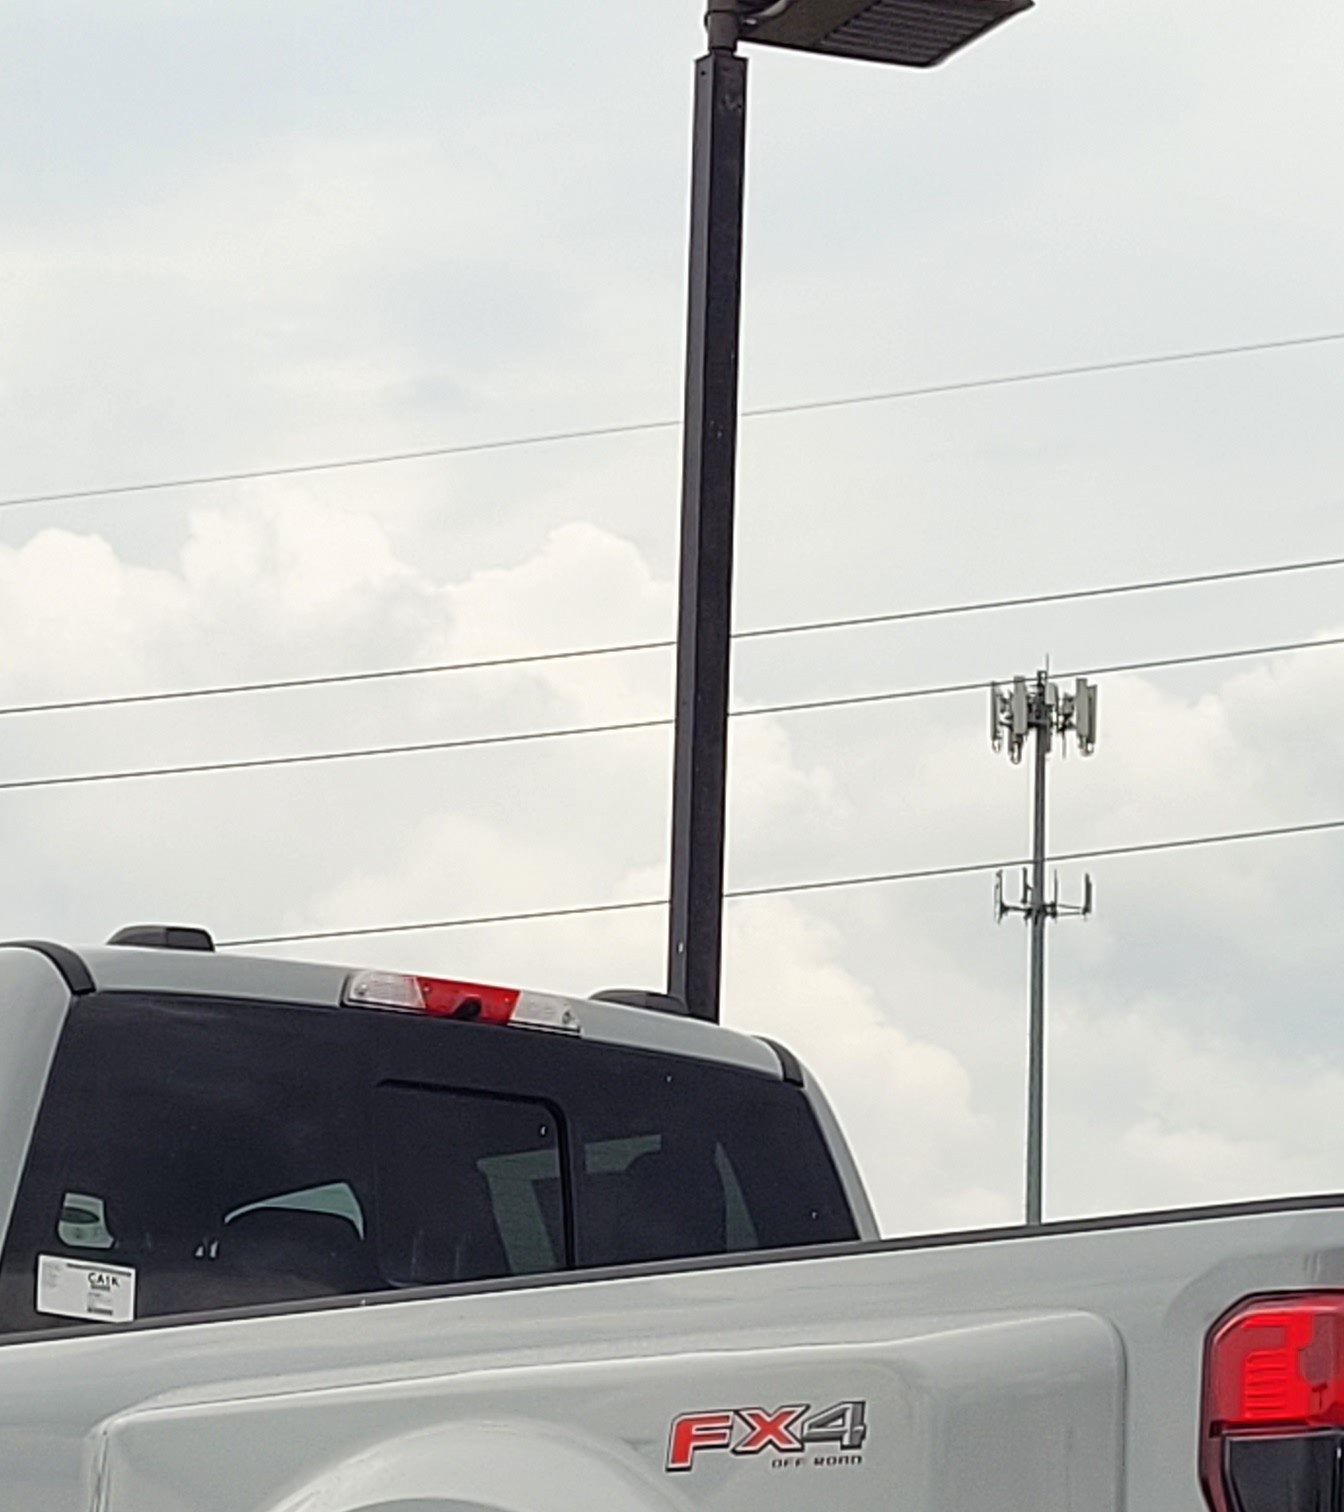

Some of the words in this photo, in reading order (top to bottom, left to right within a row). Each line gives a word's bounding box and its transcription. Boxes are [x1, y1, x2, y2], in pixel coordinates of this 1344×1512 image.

[665, 1400, 866, 1472] FX4
[772, 1458, 805, 1469] OFF
[814, 1455, 862, 1467] ROAD
